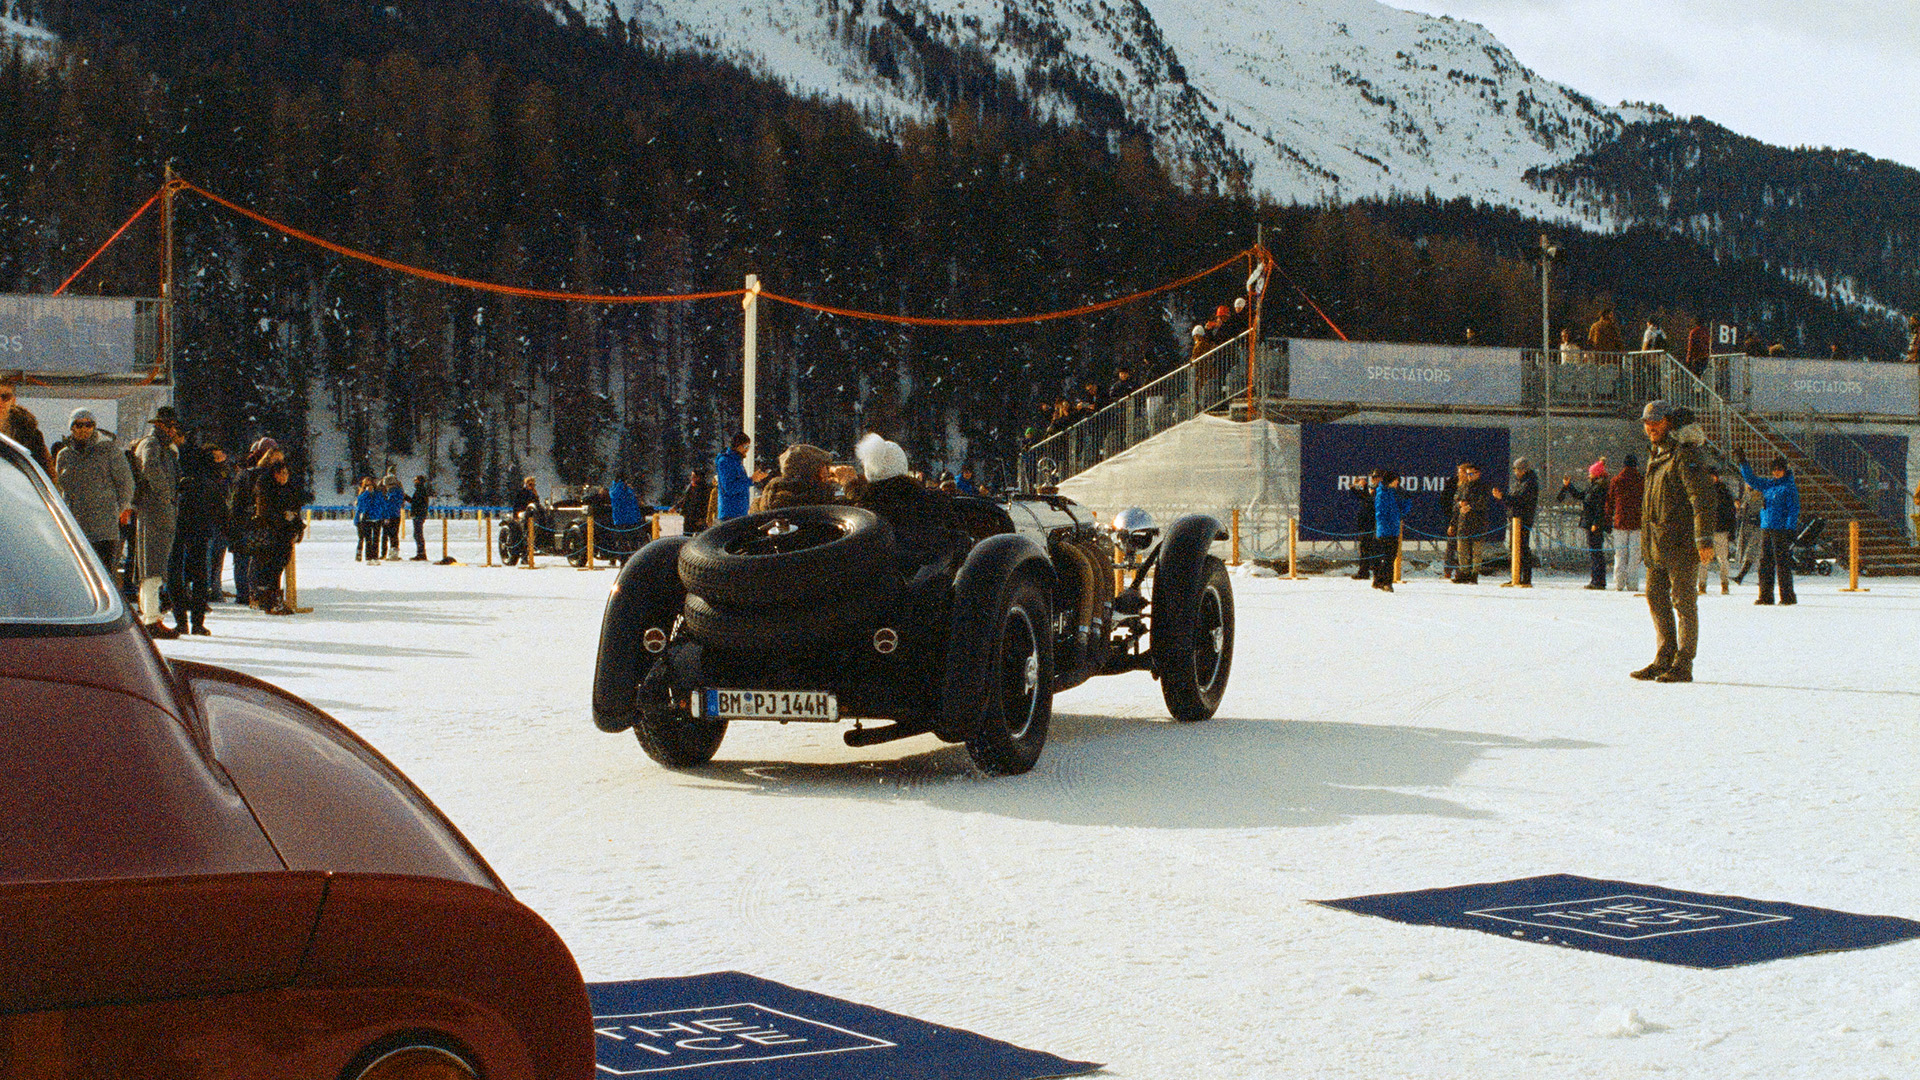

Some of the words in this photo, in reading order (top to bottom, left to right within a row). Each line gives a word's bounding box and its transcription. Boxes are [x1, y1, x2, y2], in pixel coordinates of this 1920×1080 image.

[1720, 324, 1738, 345] B1
[1367, 365, 1452, 383] SPECTATORS
[1792, 379, 1863, 395] SPECTATORS
[718, 692, 742, 714] BM
[754, 693, 777, 715] PJ
[781, 694, 828, 716] 144H
[1533, 903, 1666, 920] THE
[1598, 911, 1721, 928] ICE
[594, 1017, 761, 1040] THE
[635, 1030, 809, 1055] ICE
